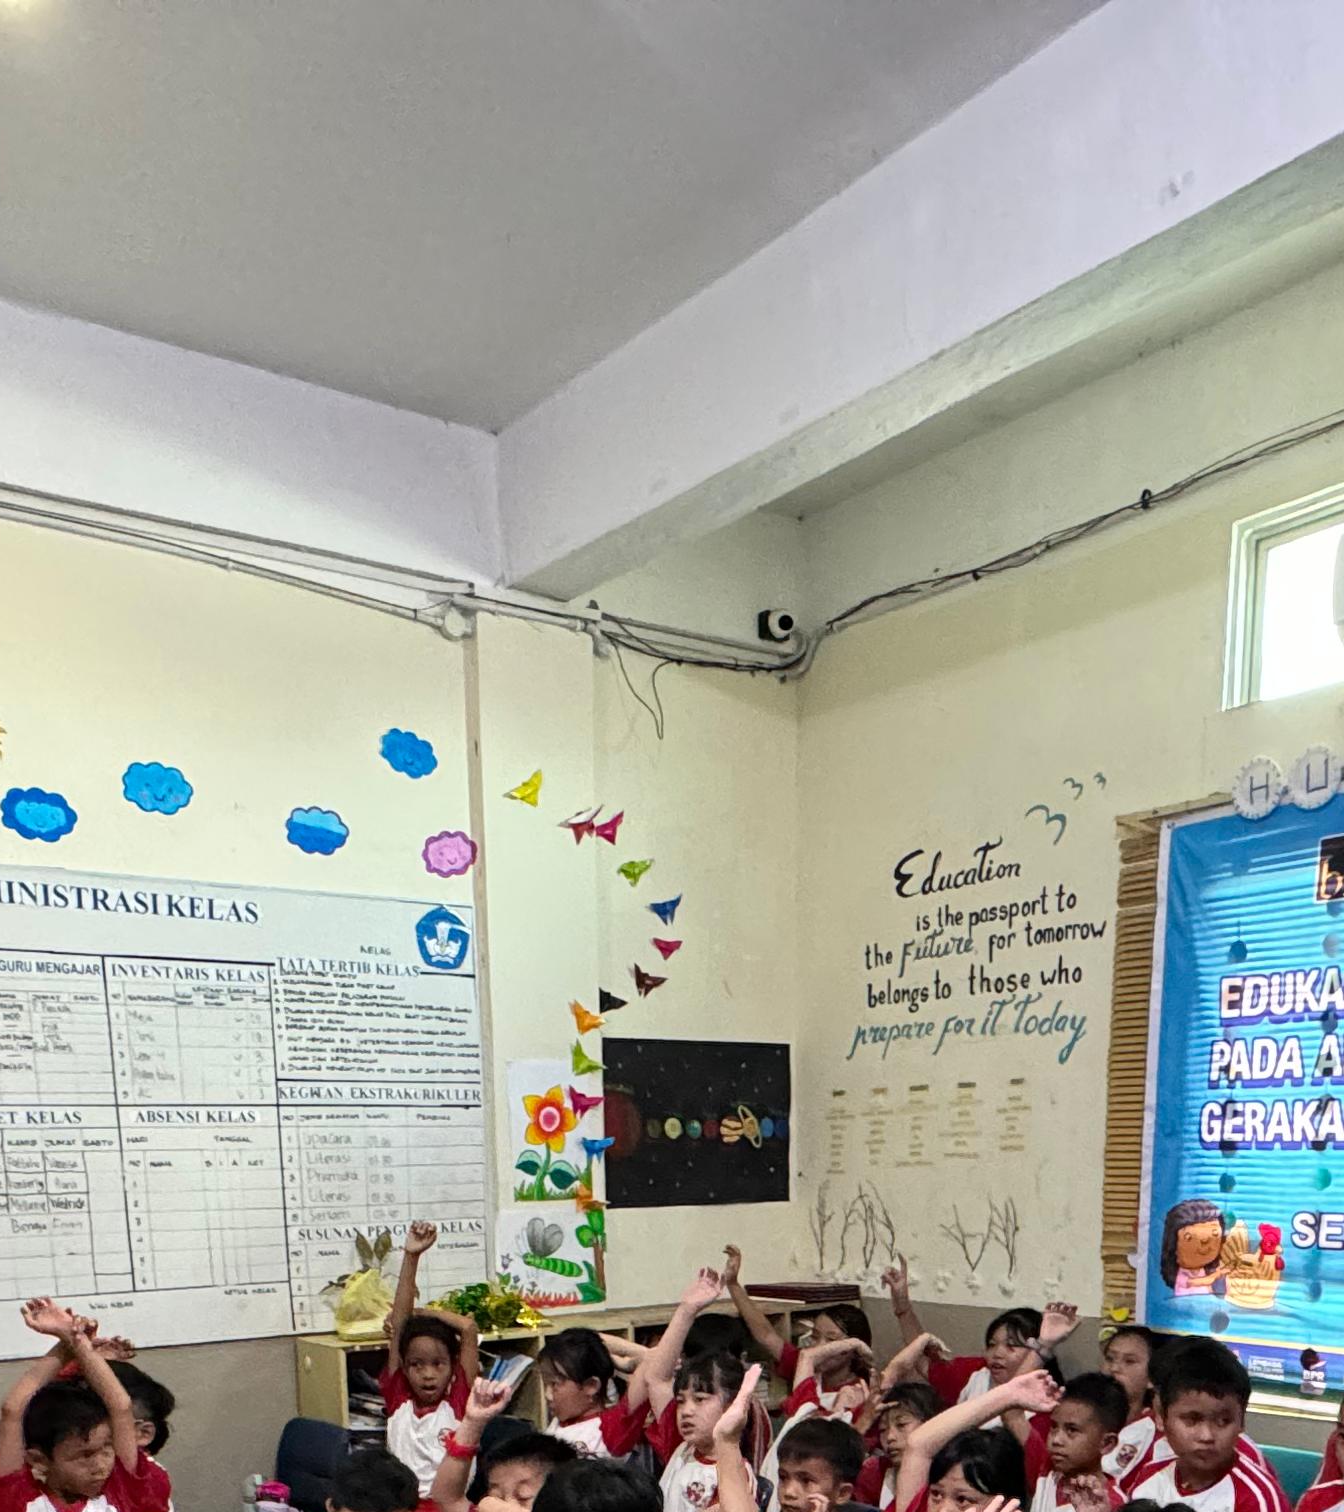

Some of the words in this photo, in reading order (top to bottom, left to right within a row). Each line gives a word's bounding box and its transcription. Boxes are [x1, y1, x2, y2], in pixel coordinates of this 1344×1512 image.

[894, 836, 1022, 898] Education
[166, 897, 260, 925] KELAS
[916, 911, 931, 931] is
[937, 904, 963, 932] the
[968, 886, 1050, 940] passport
[1056, 884, 1078, 912] to
[864, 943, 893, 971] the
[988, 930, 1017, 964] for
[1025, 919, 1107, 949] tomorrow
[36, 961, 101, 975] MENGAJAR
[111, 963, 210, 981] INVENTARIS
[216, 968, 266, 983] KELAS
[277, 957, 316, 974] TATA
[319, 959, 371, 974] TERTIB
[376, 962, 422, 977] KELAS
[867, 981, 931, 1014] belongs
[934, 971, 952, 1000] to
[968, 964, 1031, 996] those
[1040, 956, 1084, 987] who
[847, 1018, 935, 1060] prepare
[932, 1006, 974, 1057] for
[1210, 1034, 1302, 1084] PADA
[350, 1087, 482, 1101] EKSTRAKURIKULER
[27, 1111, 83, 1125] KELAS
[135, 1110, 200, 1123] ABSENSI
[206, 1110, 256, 1123] KELAS
[441, 1221, 483, 1234] KELAS
